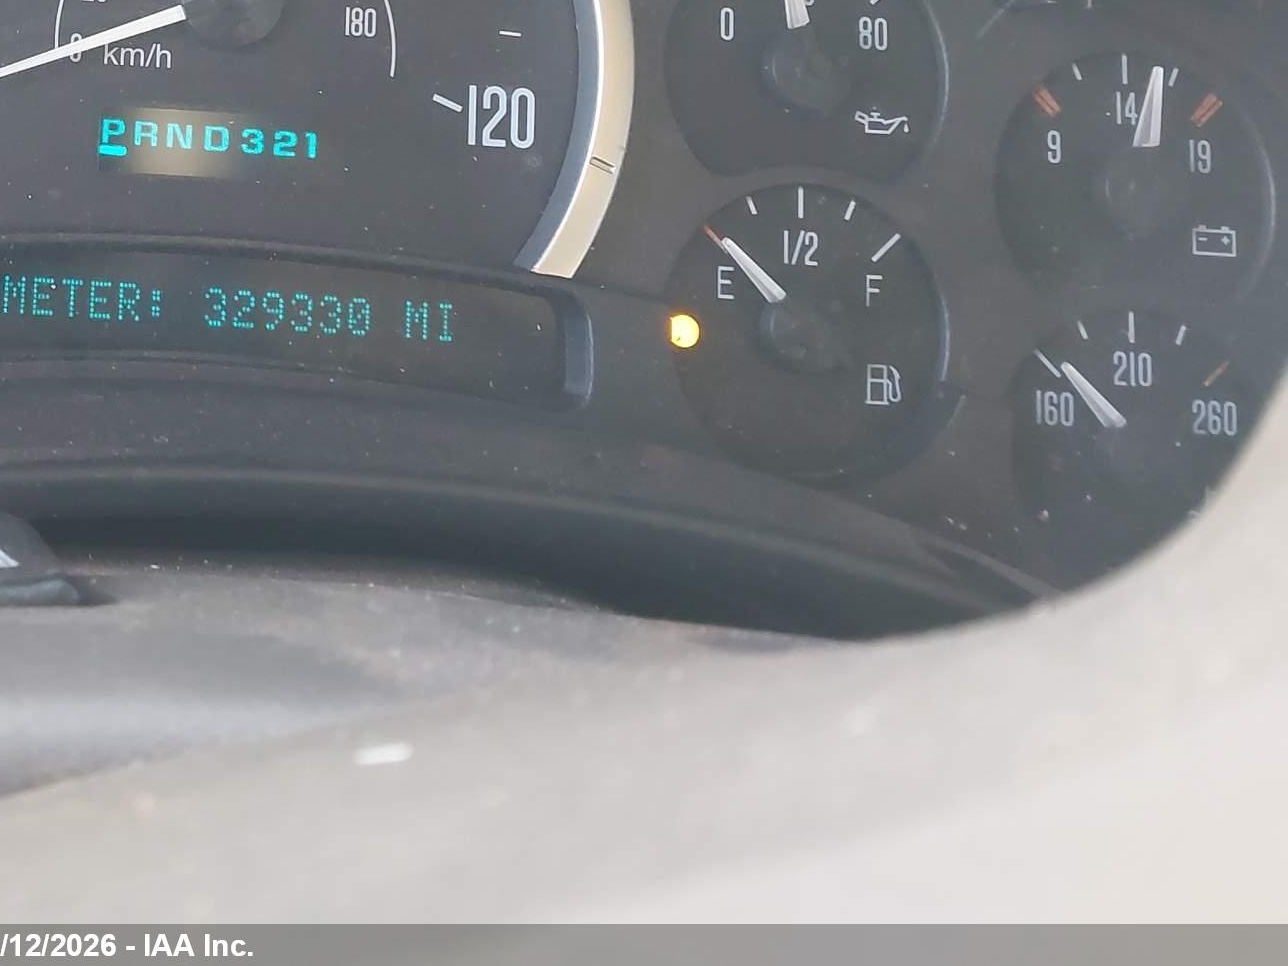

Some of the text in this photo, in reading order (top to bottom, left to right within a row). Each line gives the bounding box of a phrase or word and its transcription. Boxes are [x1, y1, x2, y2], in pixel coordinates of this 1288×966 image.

[345, 7, 376, 37] 180
[719, 7, 734, 41] 0
[859, 17, 888, 50] 80
[103, 43, 172, 70] km/h
[468, 85, 536, 149] 120
[1115, 91, 1138, 125] 14
[1047, 131, 1062, 164] 9
[1190, 139, 1212, 173] 19
[783, 231, 818, 267] 1/2
[717, 266, 735, 300] E
[866, 275, 883, 307] F
[204, 287, 371, 336] 329330
[404, 301, 454, 342] MI
[1113, 351, 1153, 388] 210
[1036, 394, 1074, 428] 160
[1192, 400, 1238, 436] 260
